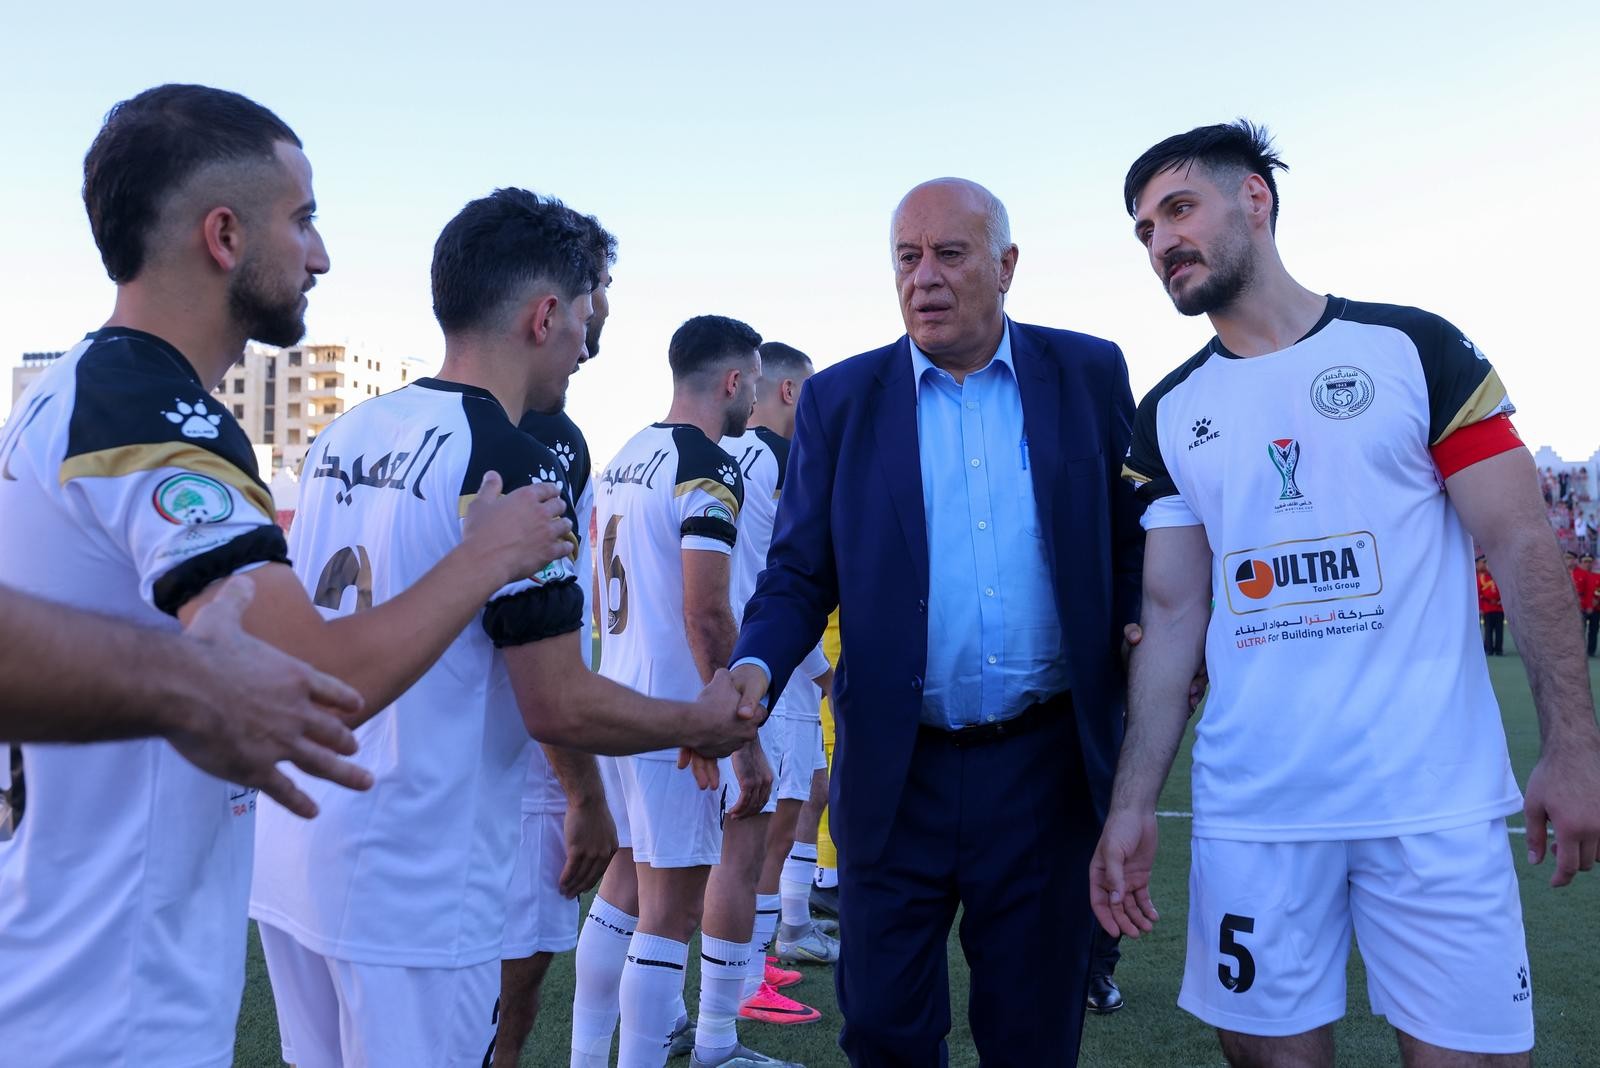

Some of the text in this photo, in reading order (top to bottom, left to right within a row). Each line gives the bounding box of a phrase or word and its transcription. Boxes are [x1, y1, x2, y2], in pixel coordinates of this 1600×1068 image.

[1188, 430, 1221, 451] KELME
[313, 425, 453, 506] العميد
[601, 447, 671, 496] العميد
[603, 514, 629, 635] 6
[1272, 547, 1360, 588] ULTRA
[1313, 581, 1361, 593] Tools Group
[1269, 615, 1303, 629] لمواد
[1337, 605, 1385, 620] شركة
[1234, 622, 1268, 637] البناء
[1236, 620, 1385, 649] ULTRA For Building Material Co.
[589, 913, 626, 935] KELME
[1218, 913, 1256, 994] 5
